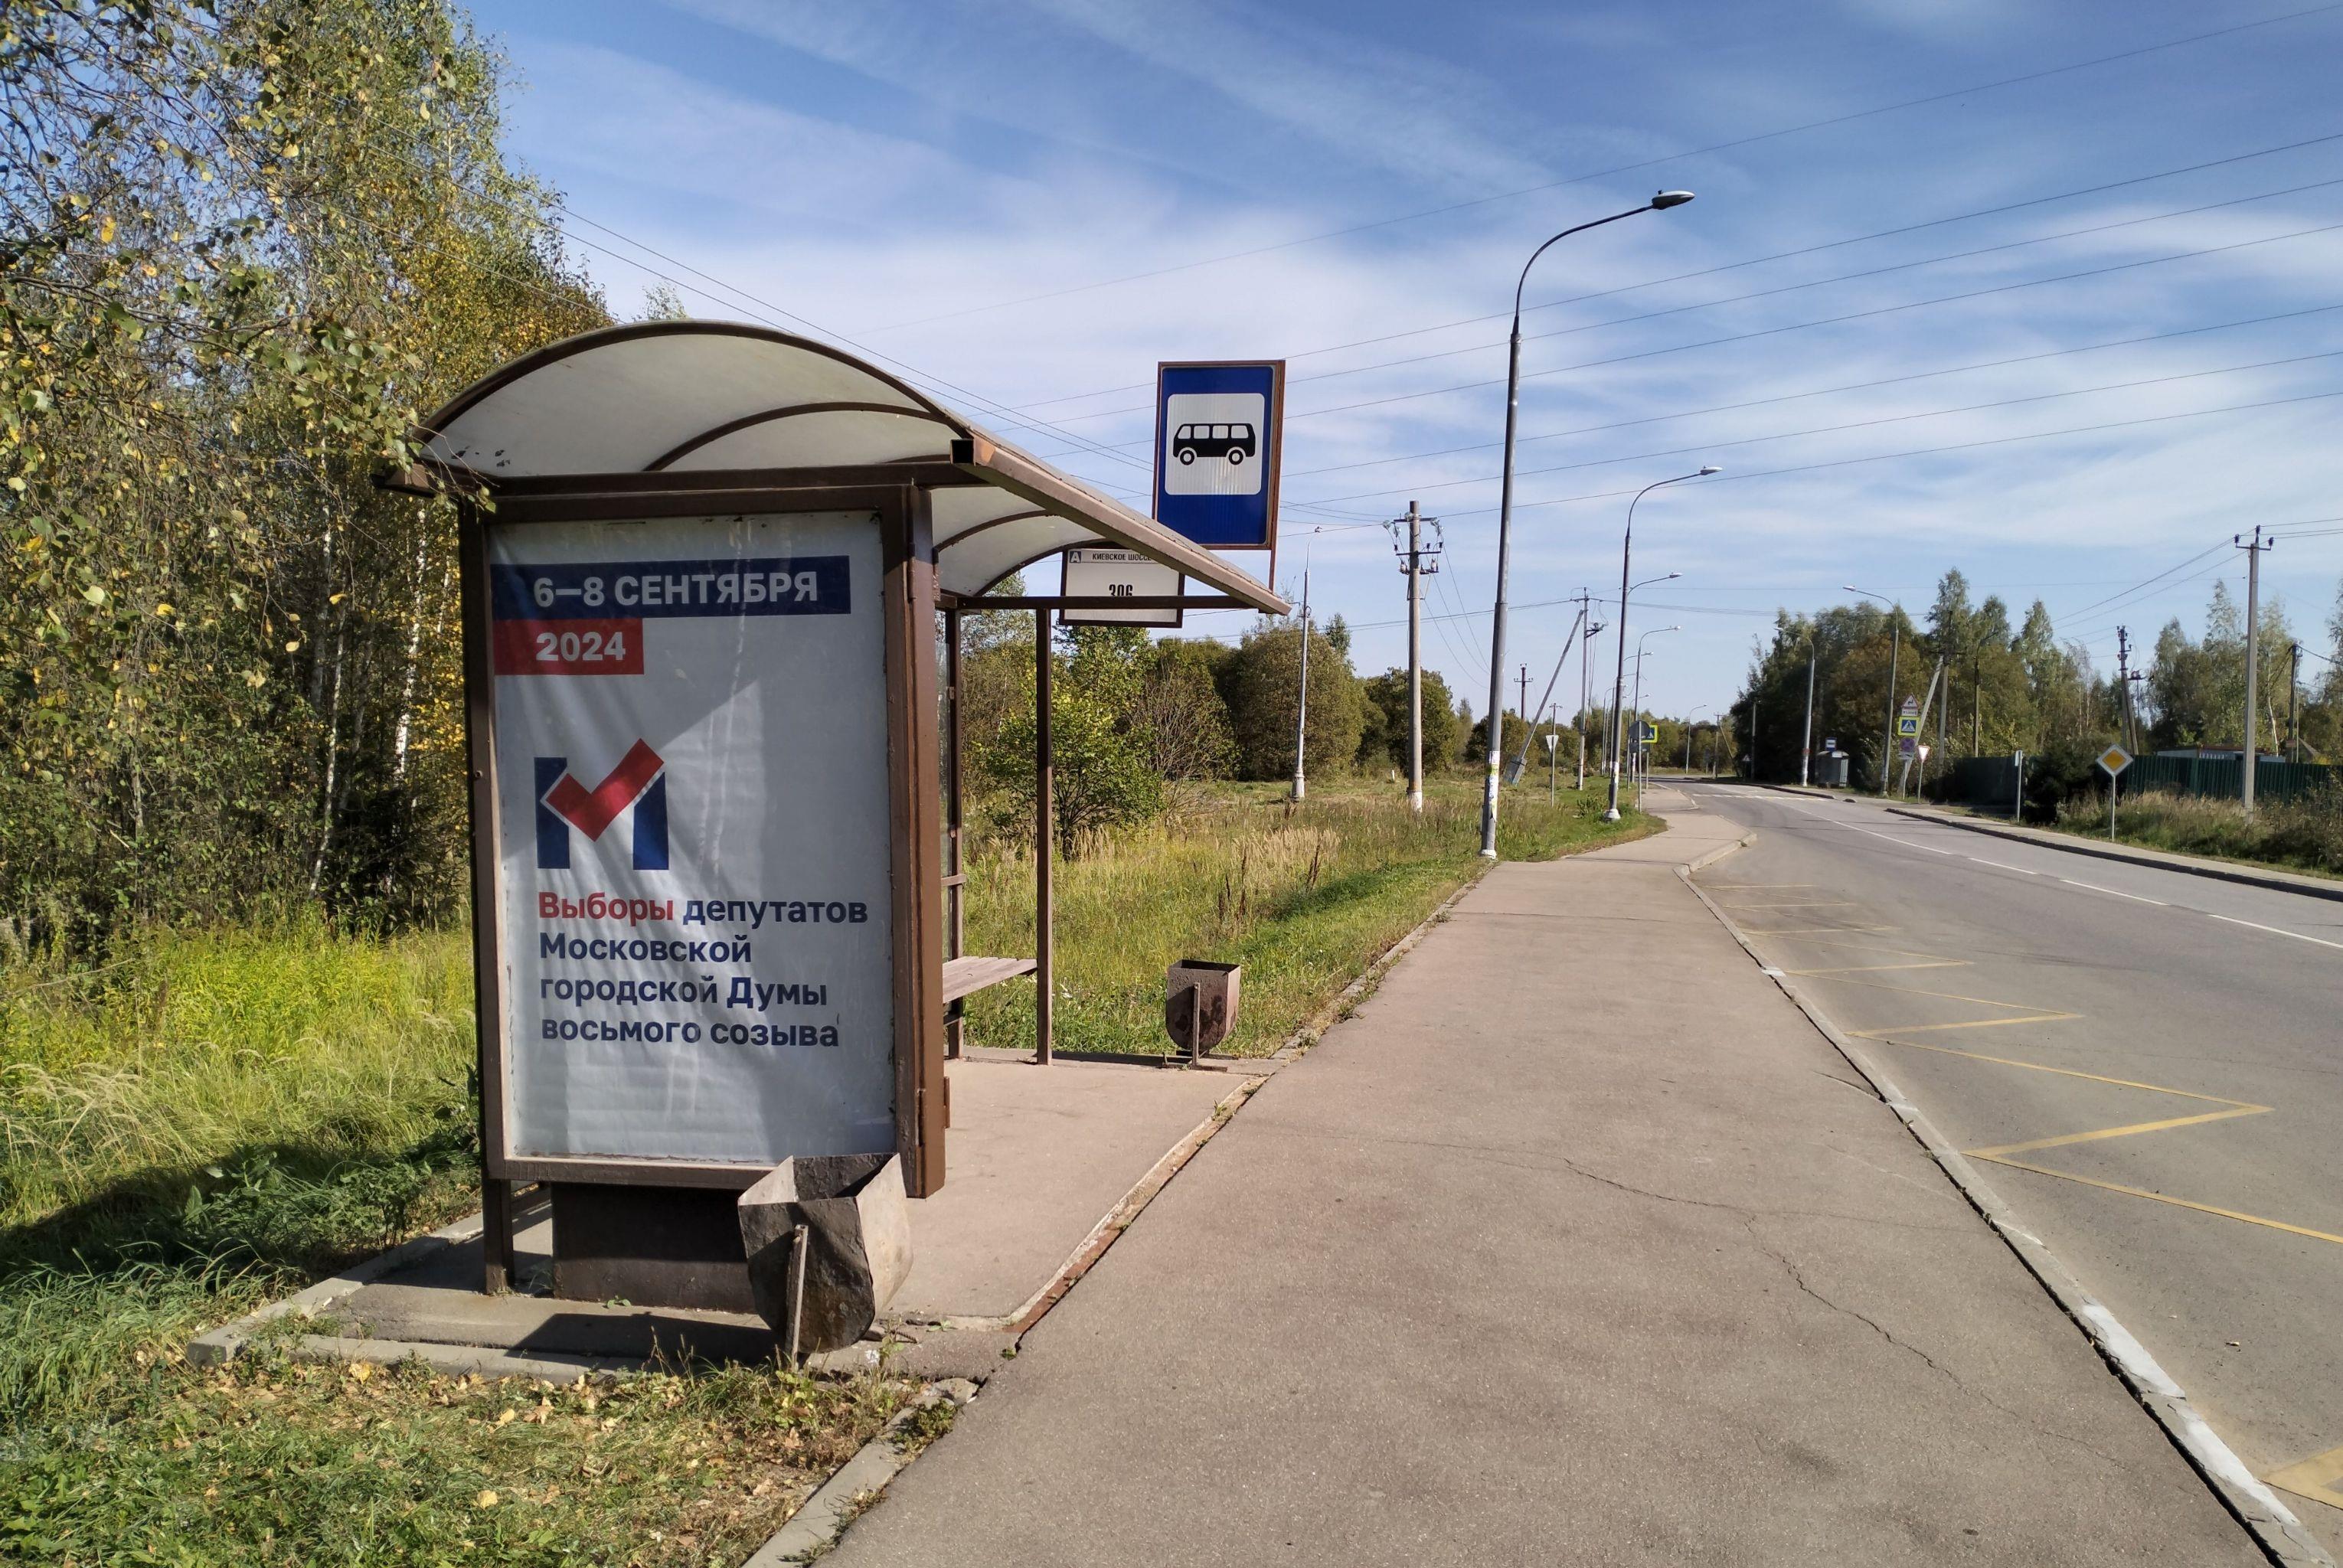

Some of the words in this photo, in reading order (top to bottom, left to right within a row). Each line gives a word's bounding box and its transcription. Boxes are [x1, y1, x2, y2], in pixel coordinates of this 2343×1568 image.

[614, 571, 819, 606] СЕНТЯБРЯ
[536, 632, 626, 662] 2024
[538, 892, 674, 926] Выборы
[682, 900, 868, 929] депутатов
[539, 932, 752, 962] Московской
[540, 975, 717, 1007] городской
[727, 977, 827, 1011] Думы
[541, 1019, 701, 1043] восьмого
[710, 1023, 840, 1047] созыва
